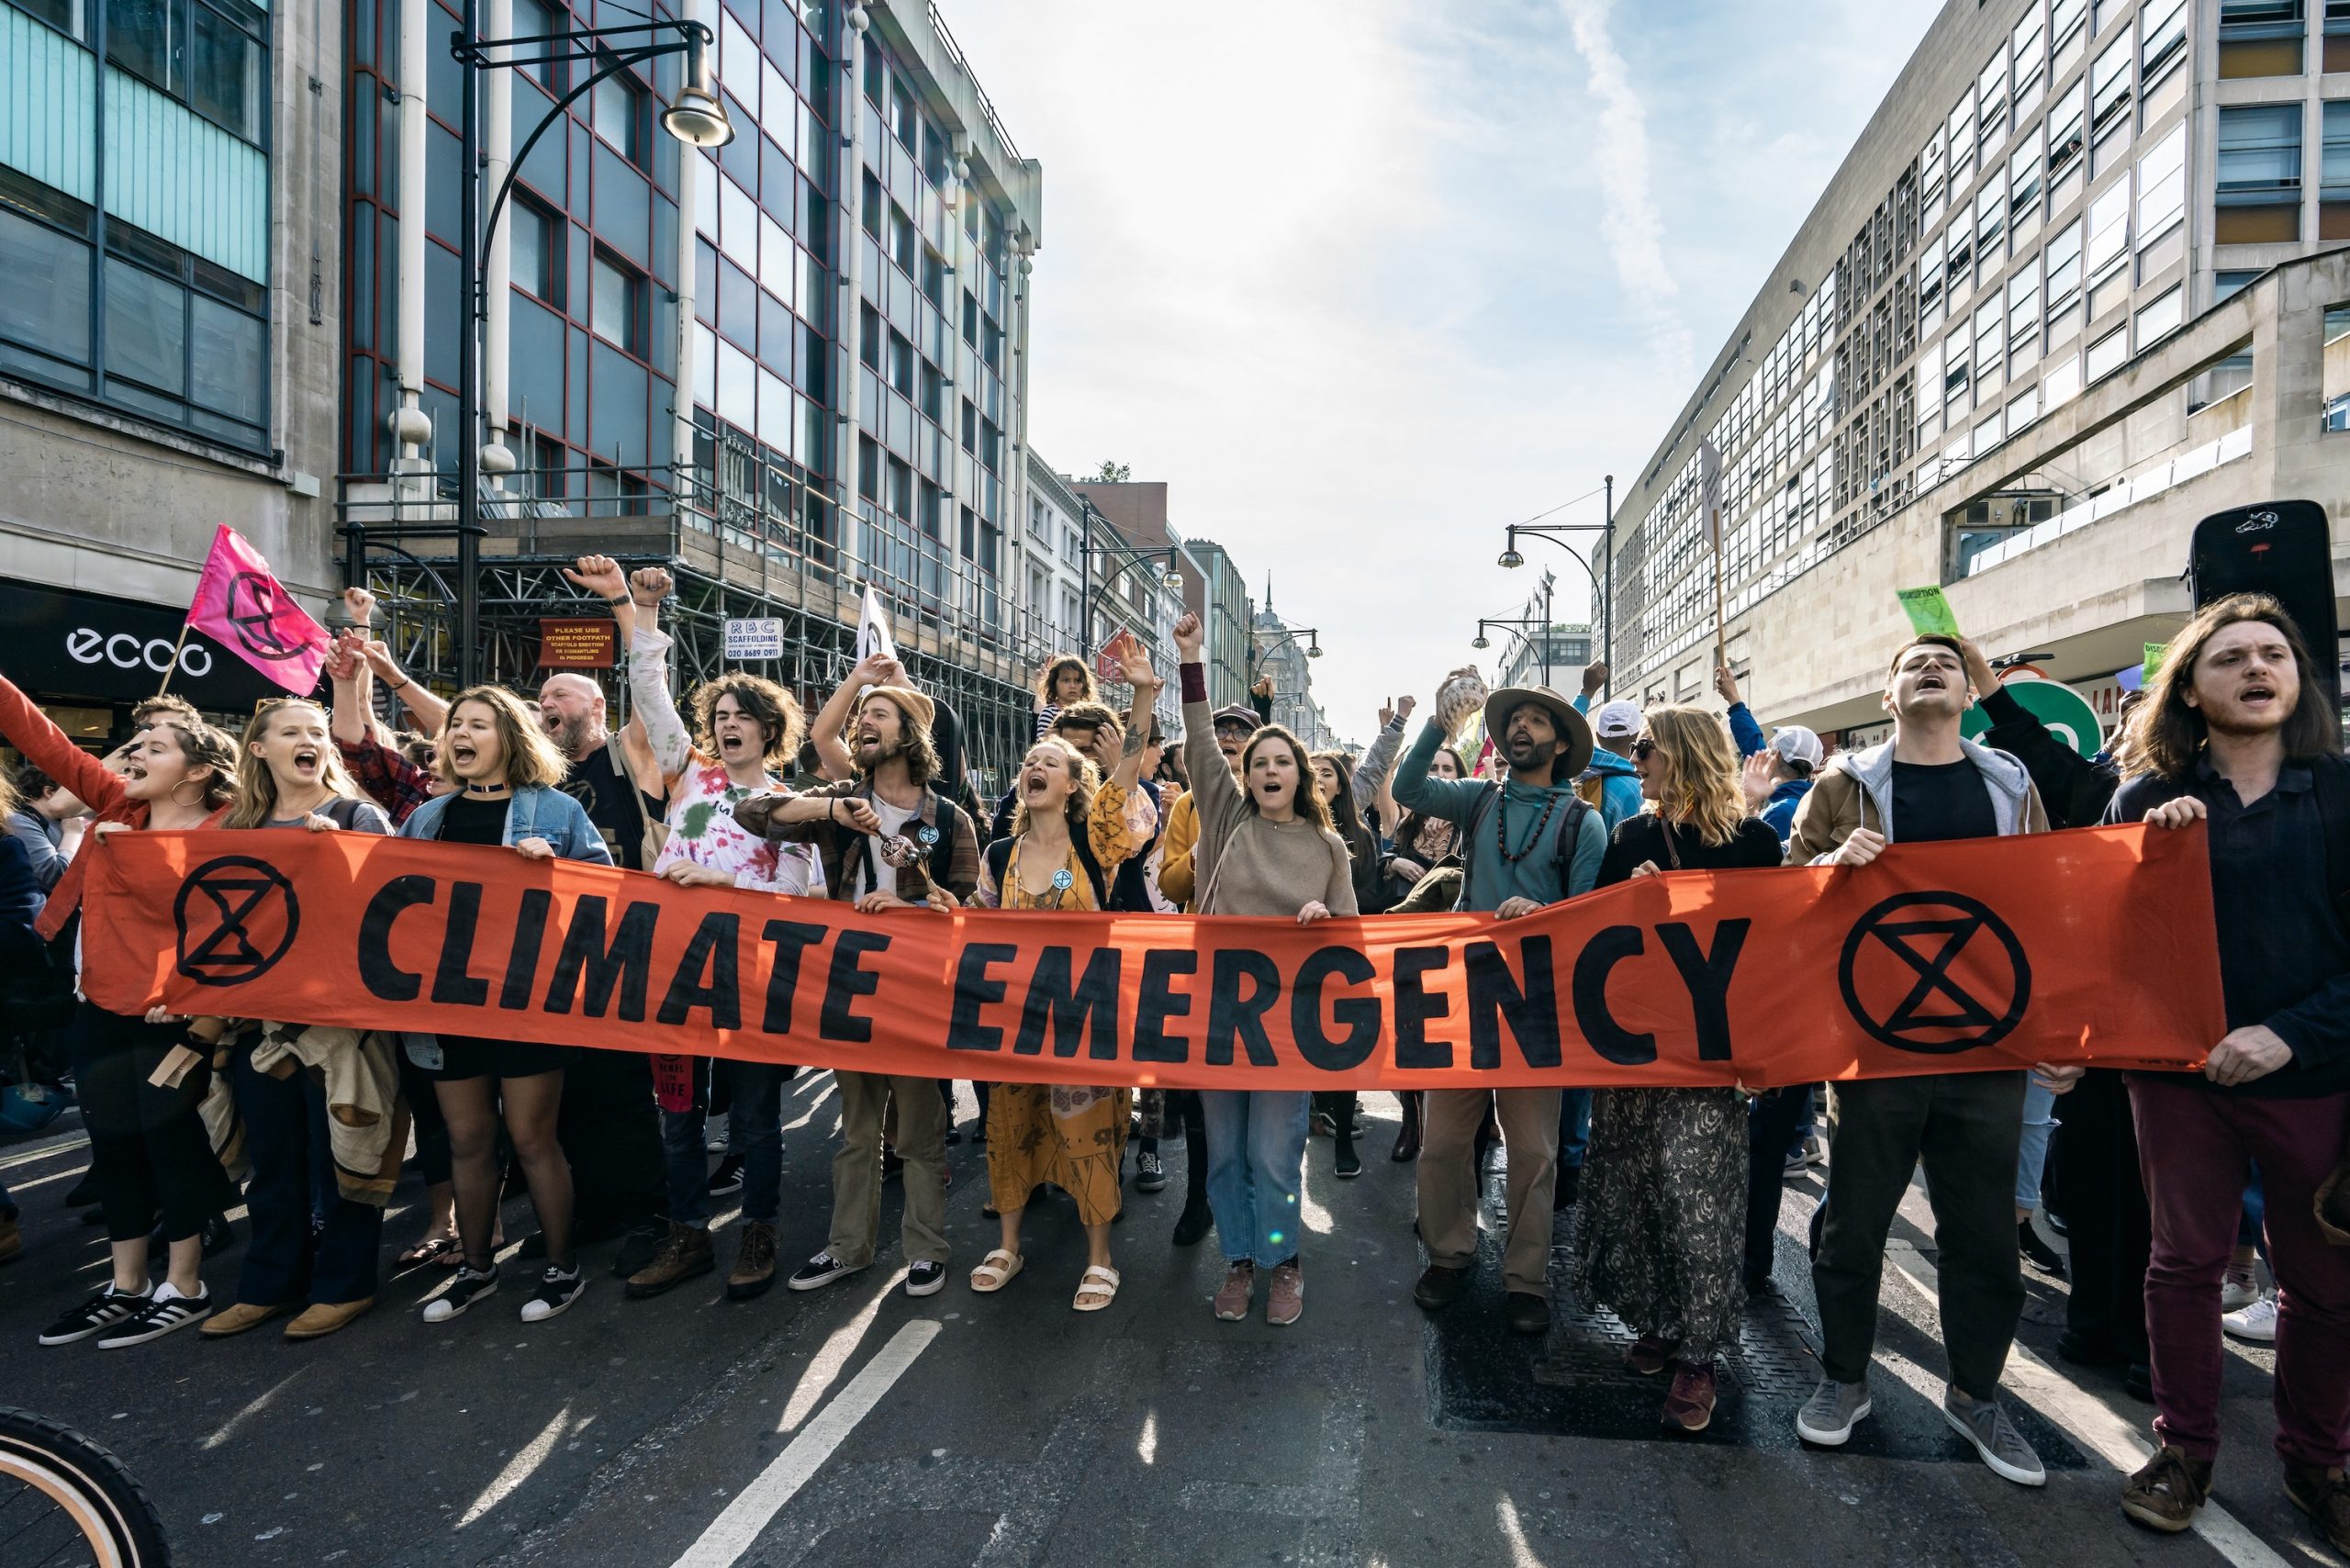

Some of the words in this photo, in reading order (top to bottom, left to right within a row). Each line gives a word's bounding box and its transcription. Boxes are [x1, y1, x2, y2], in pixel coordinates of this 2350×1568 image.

[66, 628, 212, 677] ecco
[744, 649, 761, 657] 8689
[358, 875, 893, 1043] CLIMATE
[946, 918, 1751, 1071] EMERGENCY
